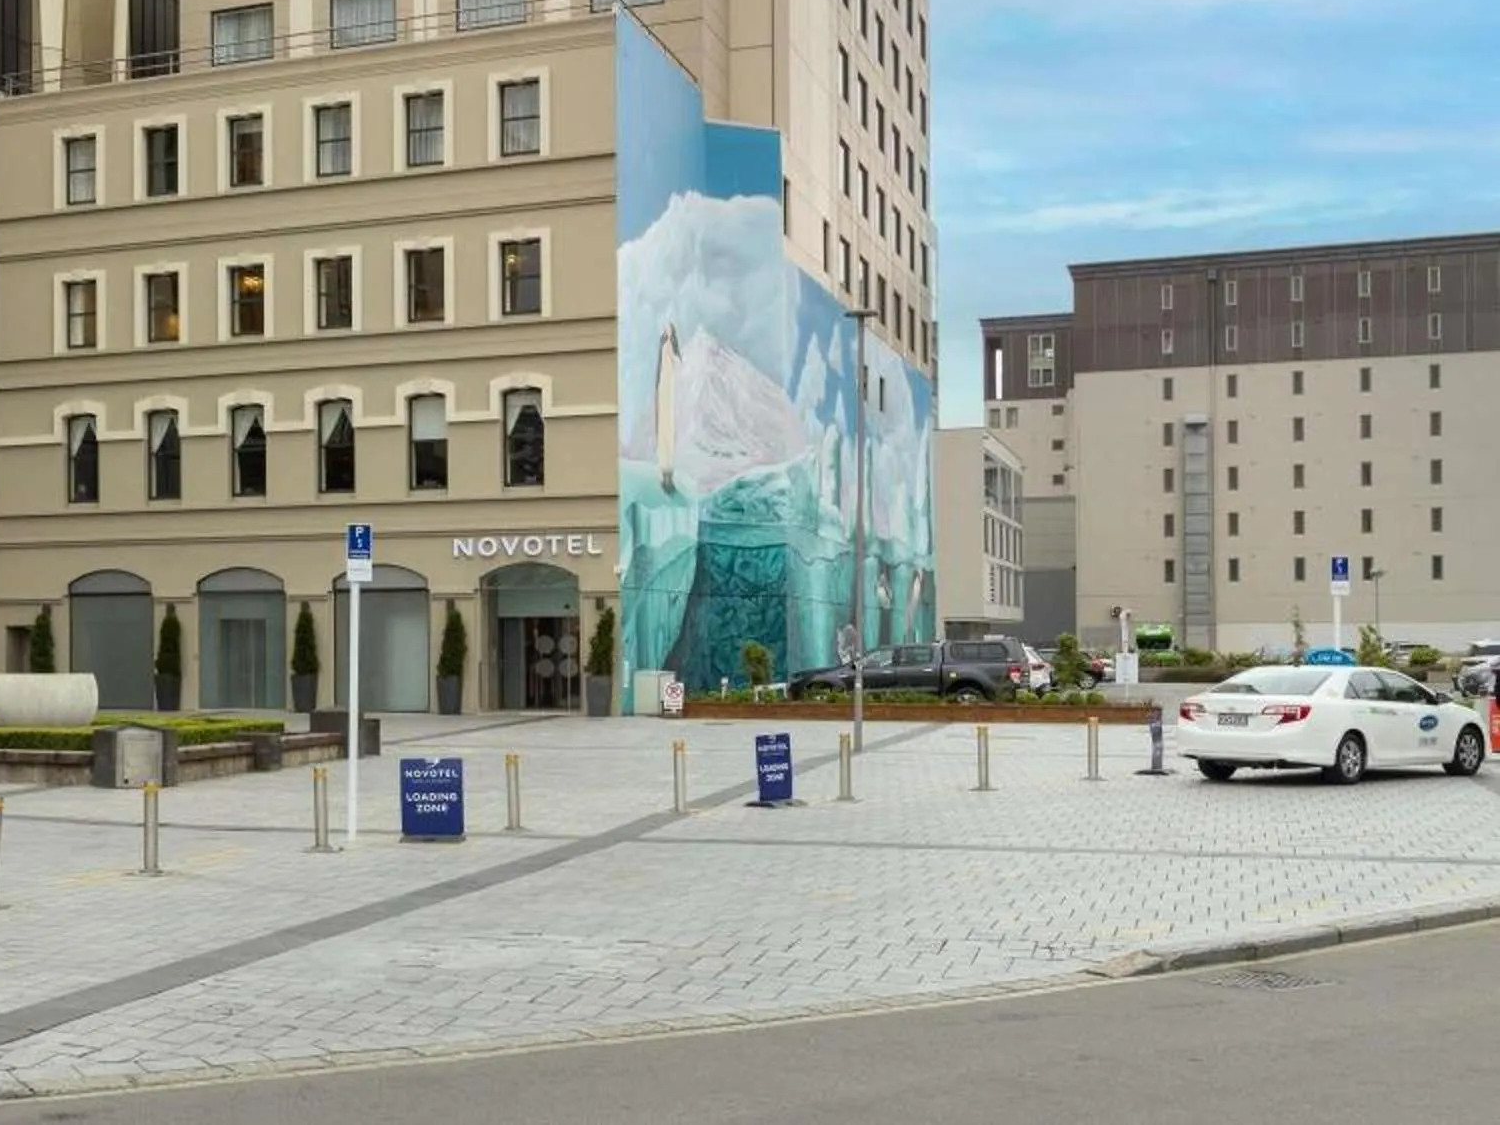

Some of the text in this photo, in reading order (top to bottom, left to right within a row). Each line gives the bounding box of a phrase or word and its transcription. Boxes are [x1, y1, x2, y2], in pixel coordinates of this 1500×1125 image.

[355, 526, 364, 538] P
[452, 533, 604, 557] NOVOTEL
[405, 768, 459, 778] NOVOTEL
[405, 792, 458, 802] LOADING
[416, 803, 449, 814] ZONE
